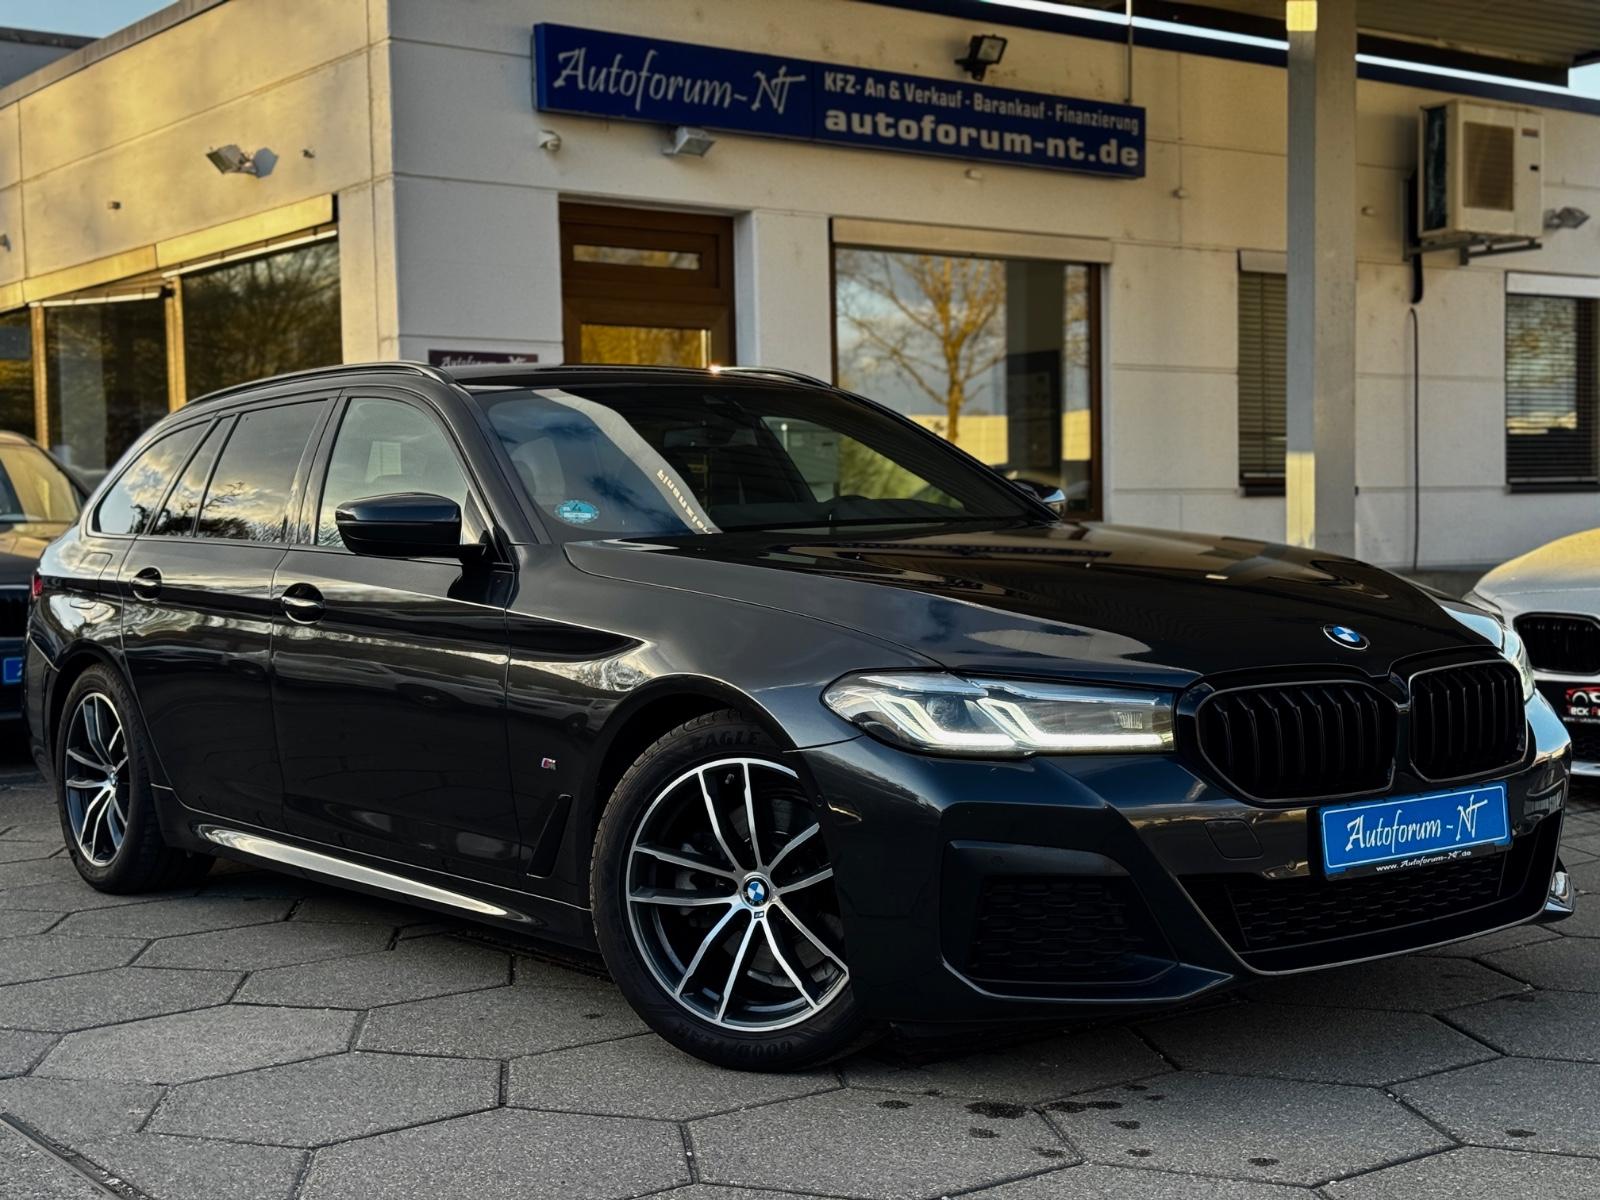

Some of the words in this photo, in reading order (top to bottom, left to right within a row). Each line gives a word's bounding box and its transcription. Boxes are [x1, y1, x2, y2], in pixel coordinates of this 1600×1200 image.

[864, 77, 885, 98] An
[889, 80, 901, 100] &
[904, 82, 962, 109] Verkauf
[973, 92, 1046, 120] Barankauf
[1055, 103, 1139, 136] Finanzierung
[824, 109, 1139, 167] autoforum-nt.de
